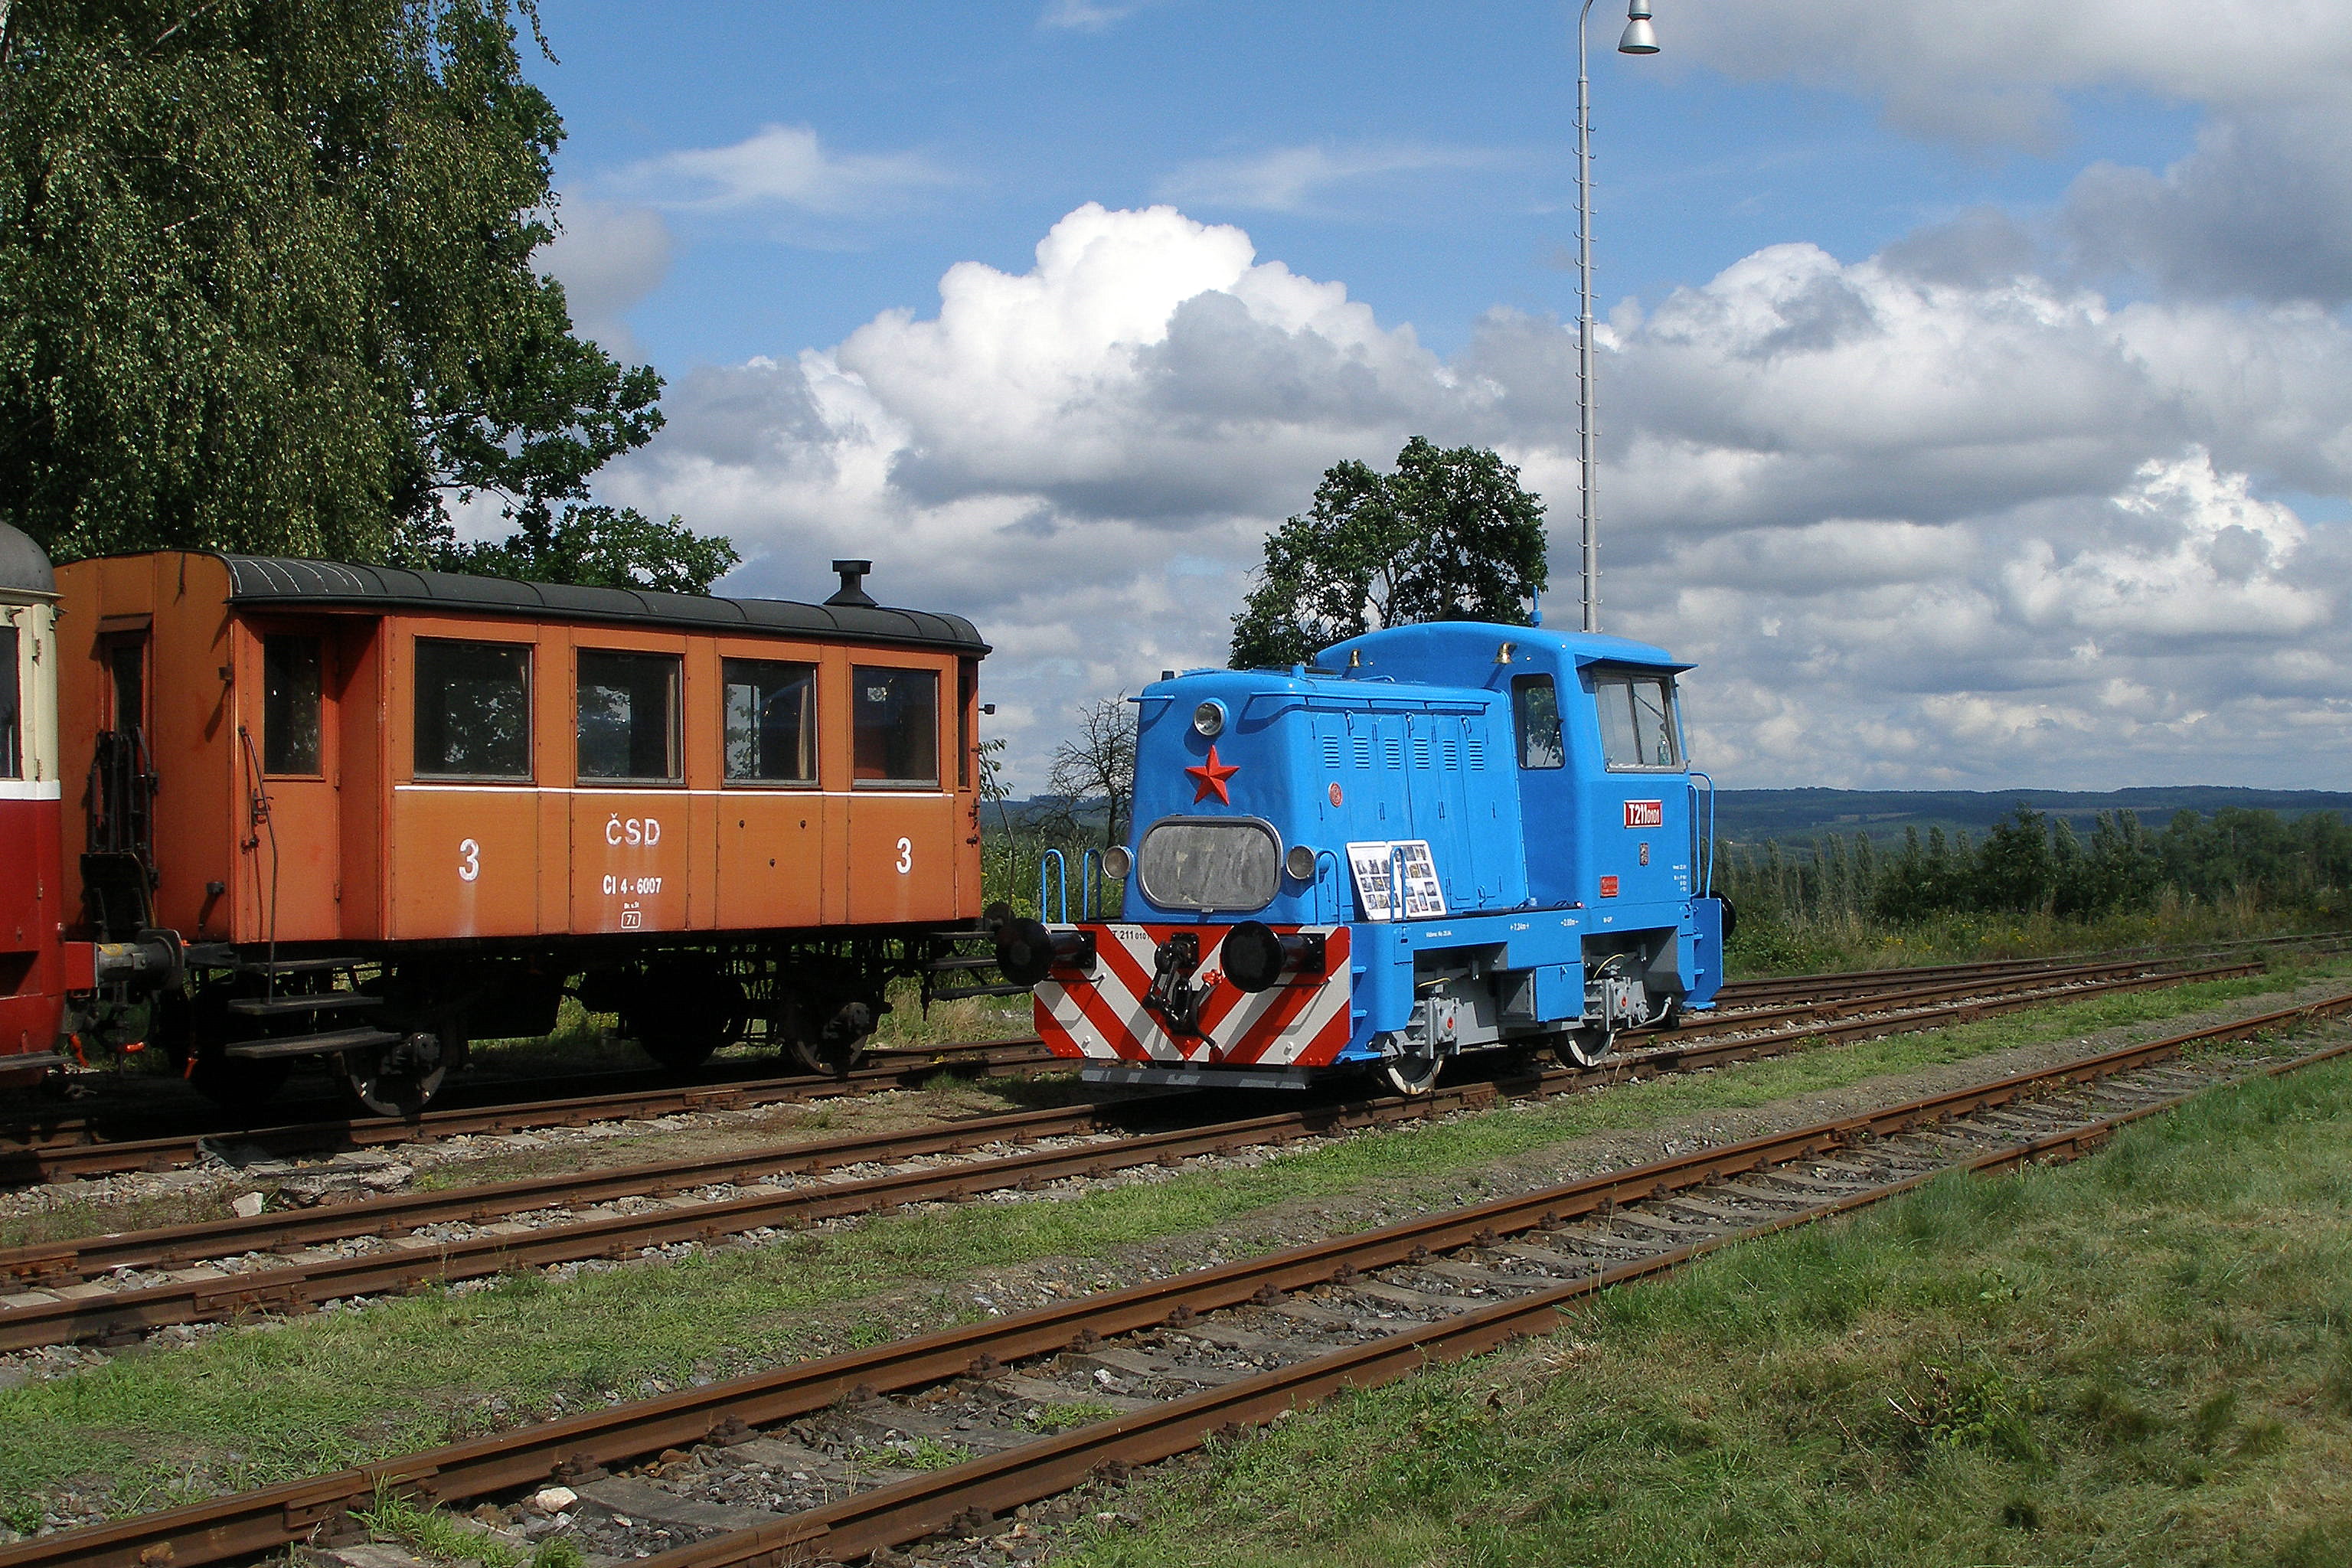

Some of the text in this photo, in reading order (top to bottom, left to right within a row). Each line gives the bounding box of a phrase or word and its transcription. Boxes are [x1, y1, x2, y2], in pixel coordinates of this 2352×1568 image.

[606, 812, 661, 845] ČSD
[459, 838, 479, 881] 3
[896, 837, 912, 874] 3
